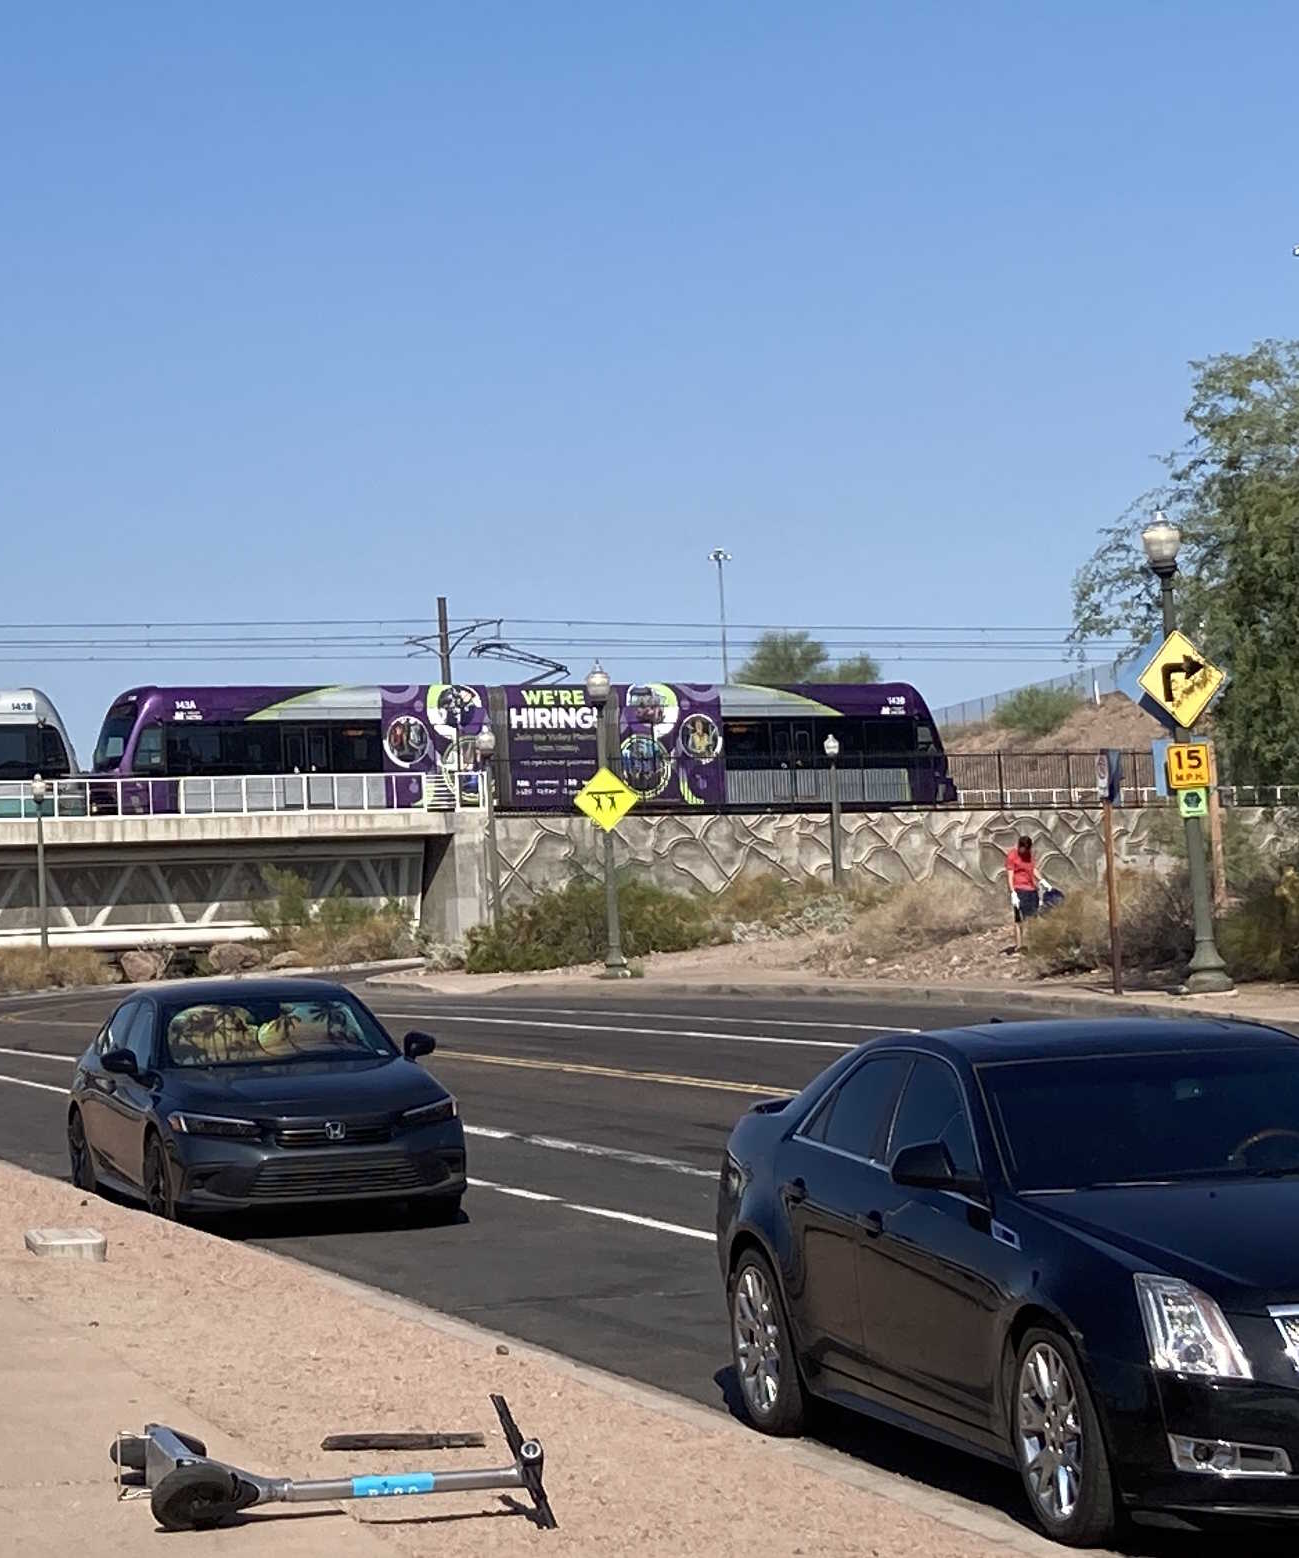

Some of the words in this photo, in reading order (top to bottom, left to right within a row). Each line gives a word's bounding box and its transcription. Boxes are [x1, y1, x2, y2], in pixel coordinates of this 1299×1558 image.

[521, 690, 586, 705] WE'RE
[509, 707, 598, 729] HIRING!
[1175, 750, 1203, 770] 15
